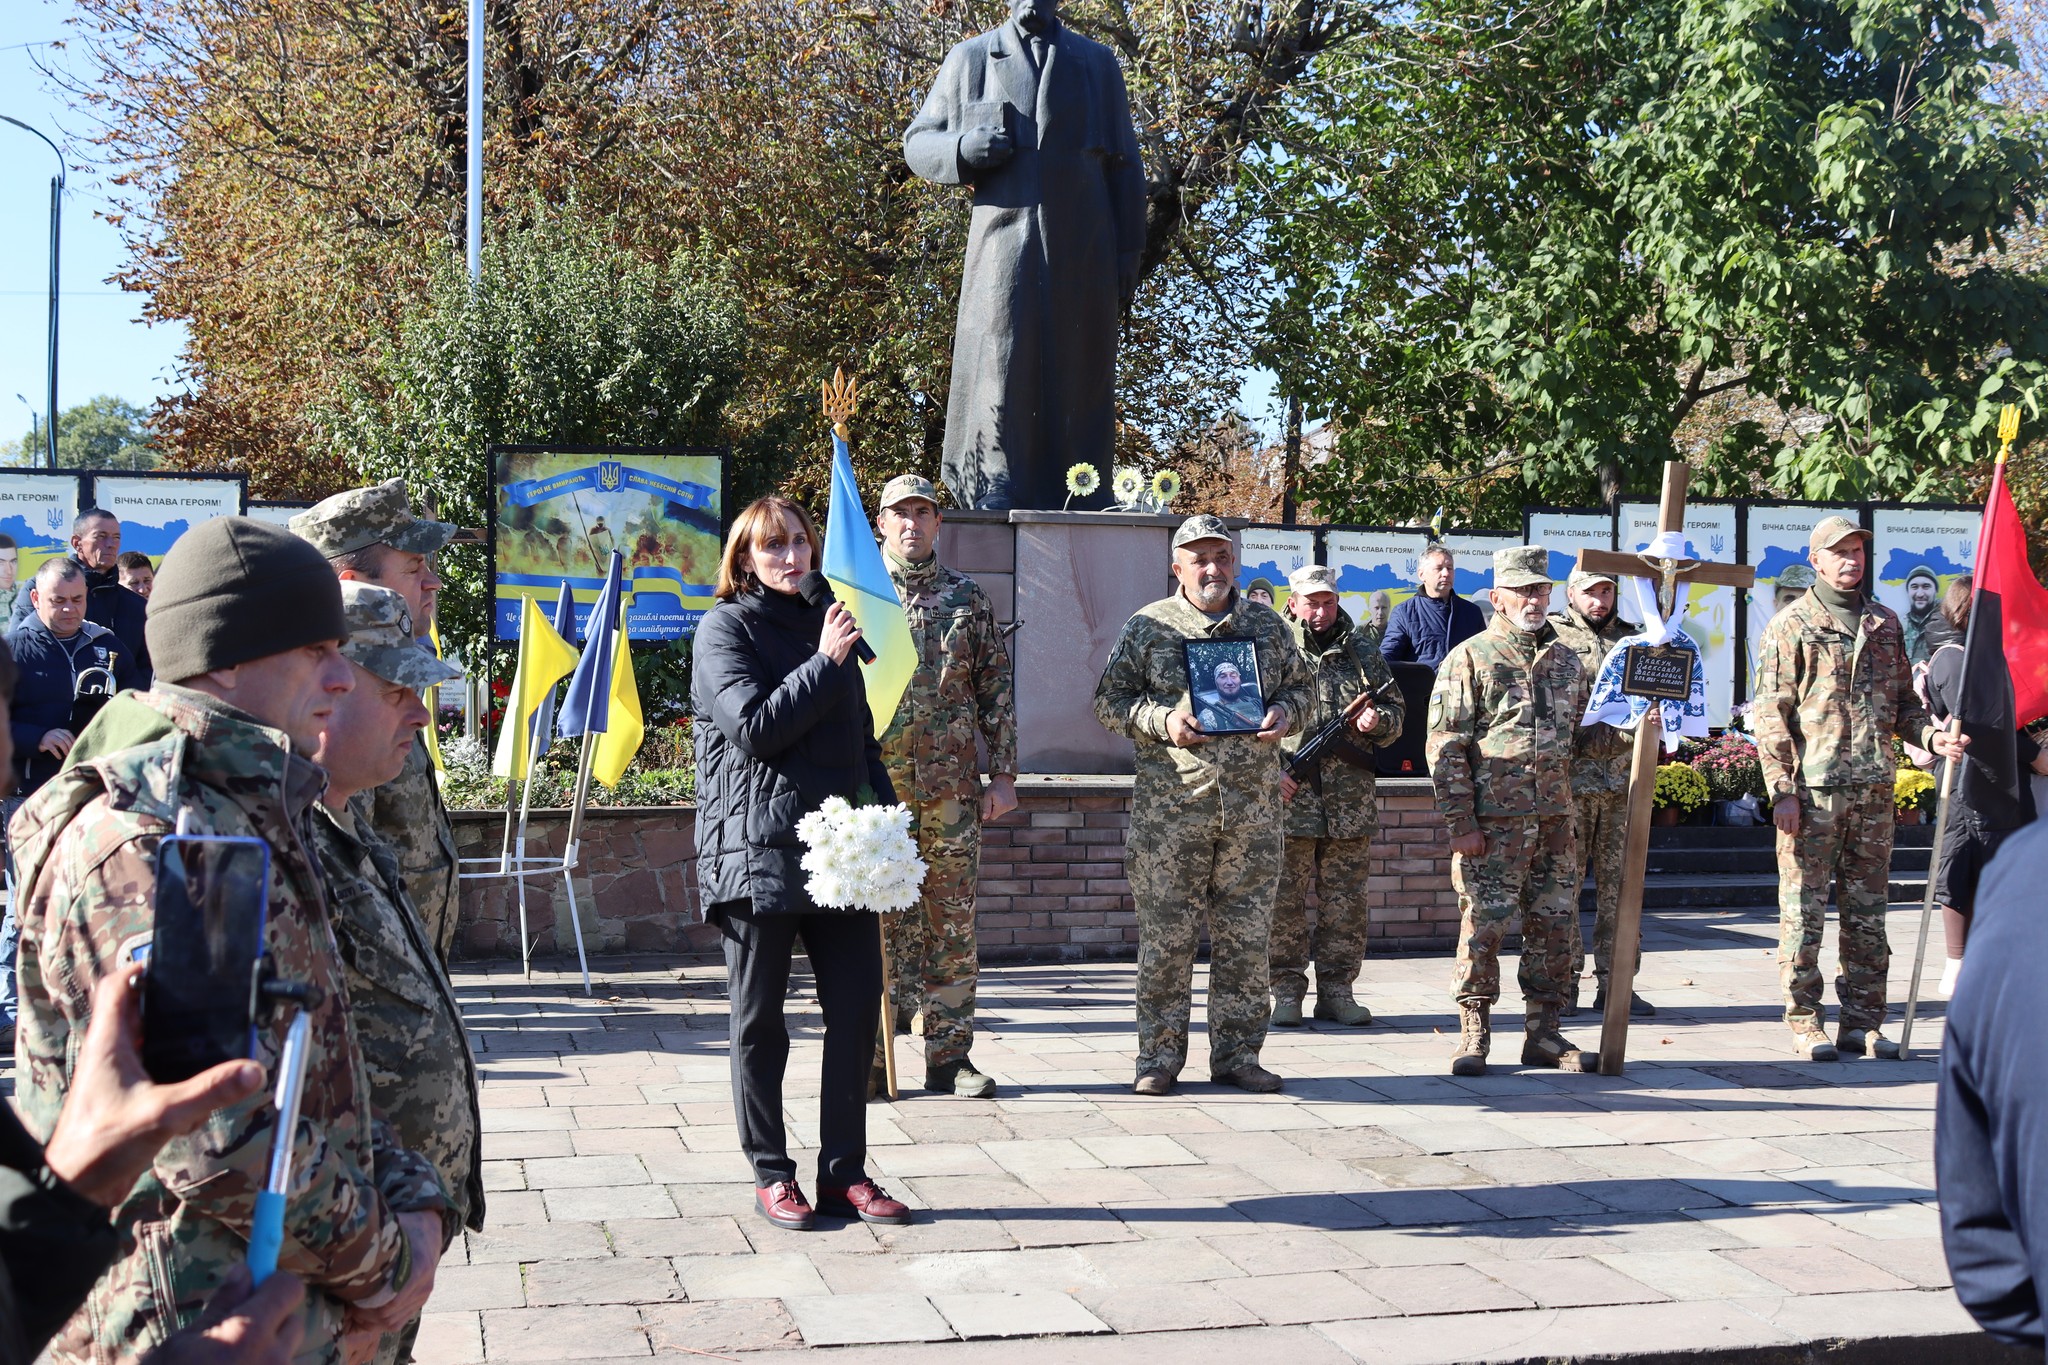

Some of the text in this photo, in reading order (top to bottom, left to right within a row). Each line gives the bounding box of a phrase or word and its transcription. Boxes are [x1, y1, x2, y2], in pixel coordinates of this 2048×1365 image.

[526, 489, 543, 499] ГЕРОЇ
[543, 485, 552, 493] НЕ
[628, 475, 648, 485] СЛАВА
[677, 489, 695, 501] СОТНІ
[17, 493, 59, 502] ГЕРОЯМ!
[114, 496, 222, 507] ВІЧНА СЛАВА ГЕРОЯМ!
[1634, 520, 1658, 528] ВІЧНА
[1686, 521, 1721, 529] ГЕРОЯМ!
[1761, 523, 1785, 531] ВІЧНА
[1786, 524, 1811, 532] СЛАВА
[1543, 529, 1613, 538] ВІЧНА СЛАВА ГЕРО
[1886, 526, 1968, 535] ВІЧНА СЛАВА ГЕРОЯМ!
[1246, 543, 1270, 551] СЛАВА
[1270, 544, 1301, 552] ГЕРОЯМ!
[1451, 548, 1494, 557] ВІЧНА СЛАВА
[505, 612, 516, 623] Це
[628, 612, 659, 623] загиблі
[685, 612, 691, 621] й
[627, 626, 637, 635] за
[637, 624, 681, 635] майбутнє
